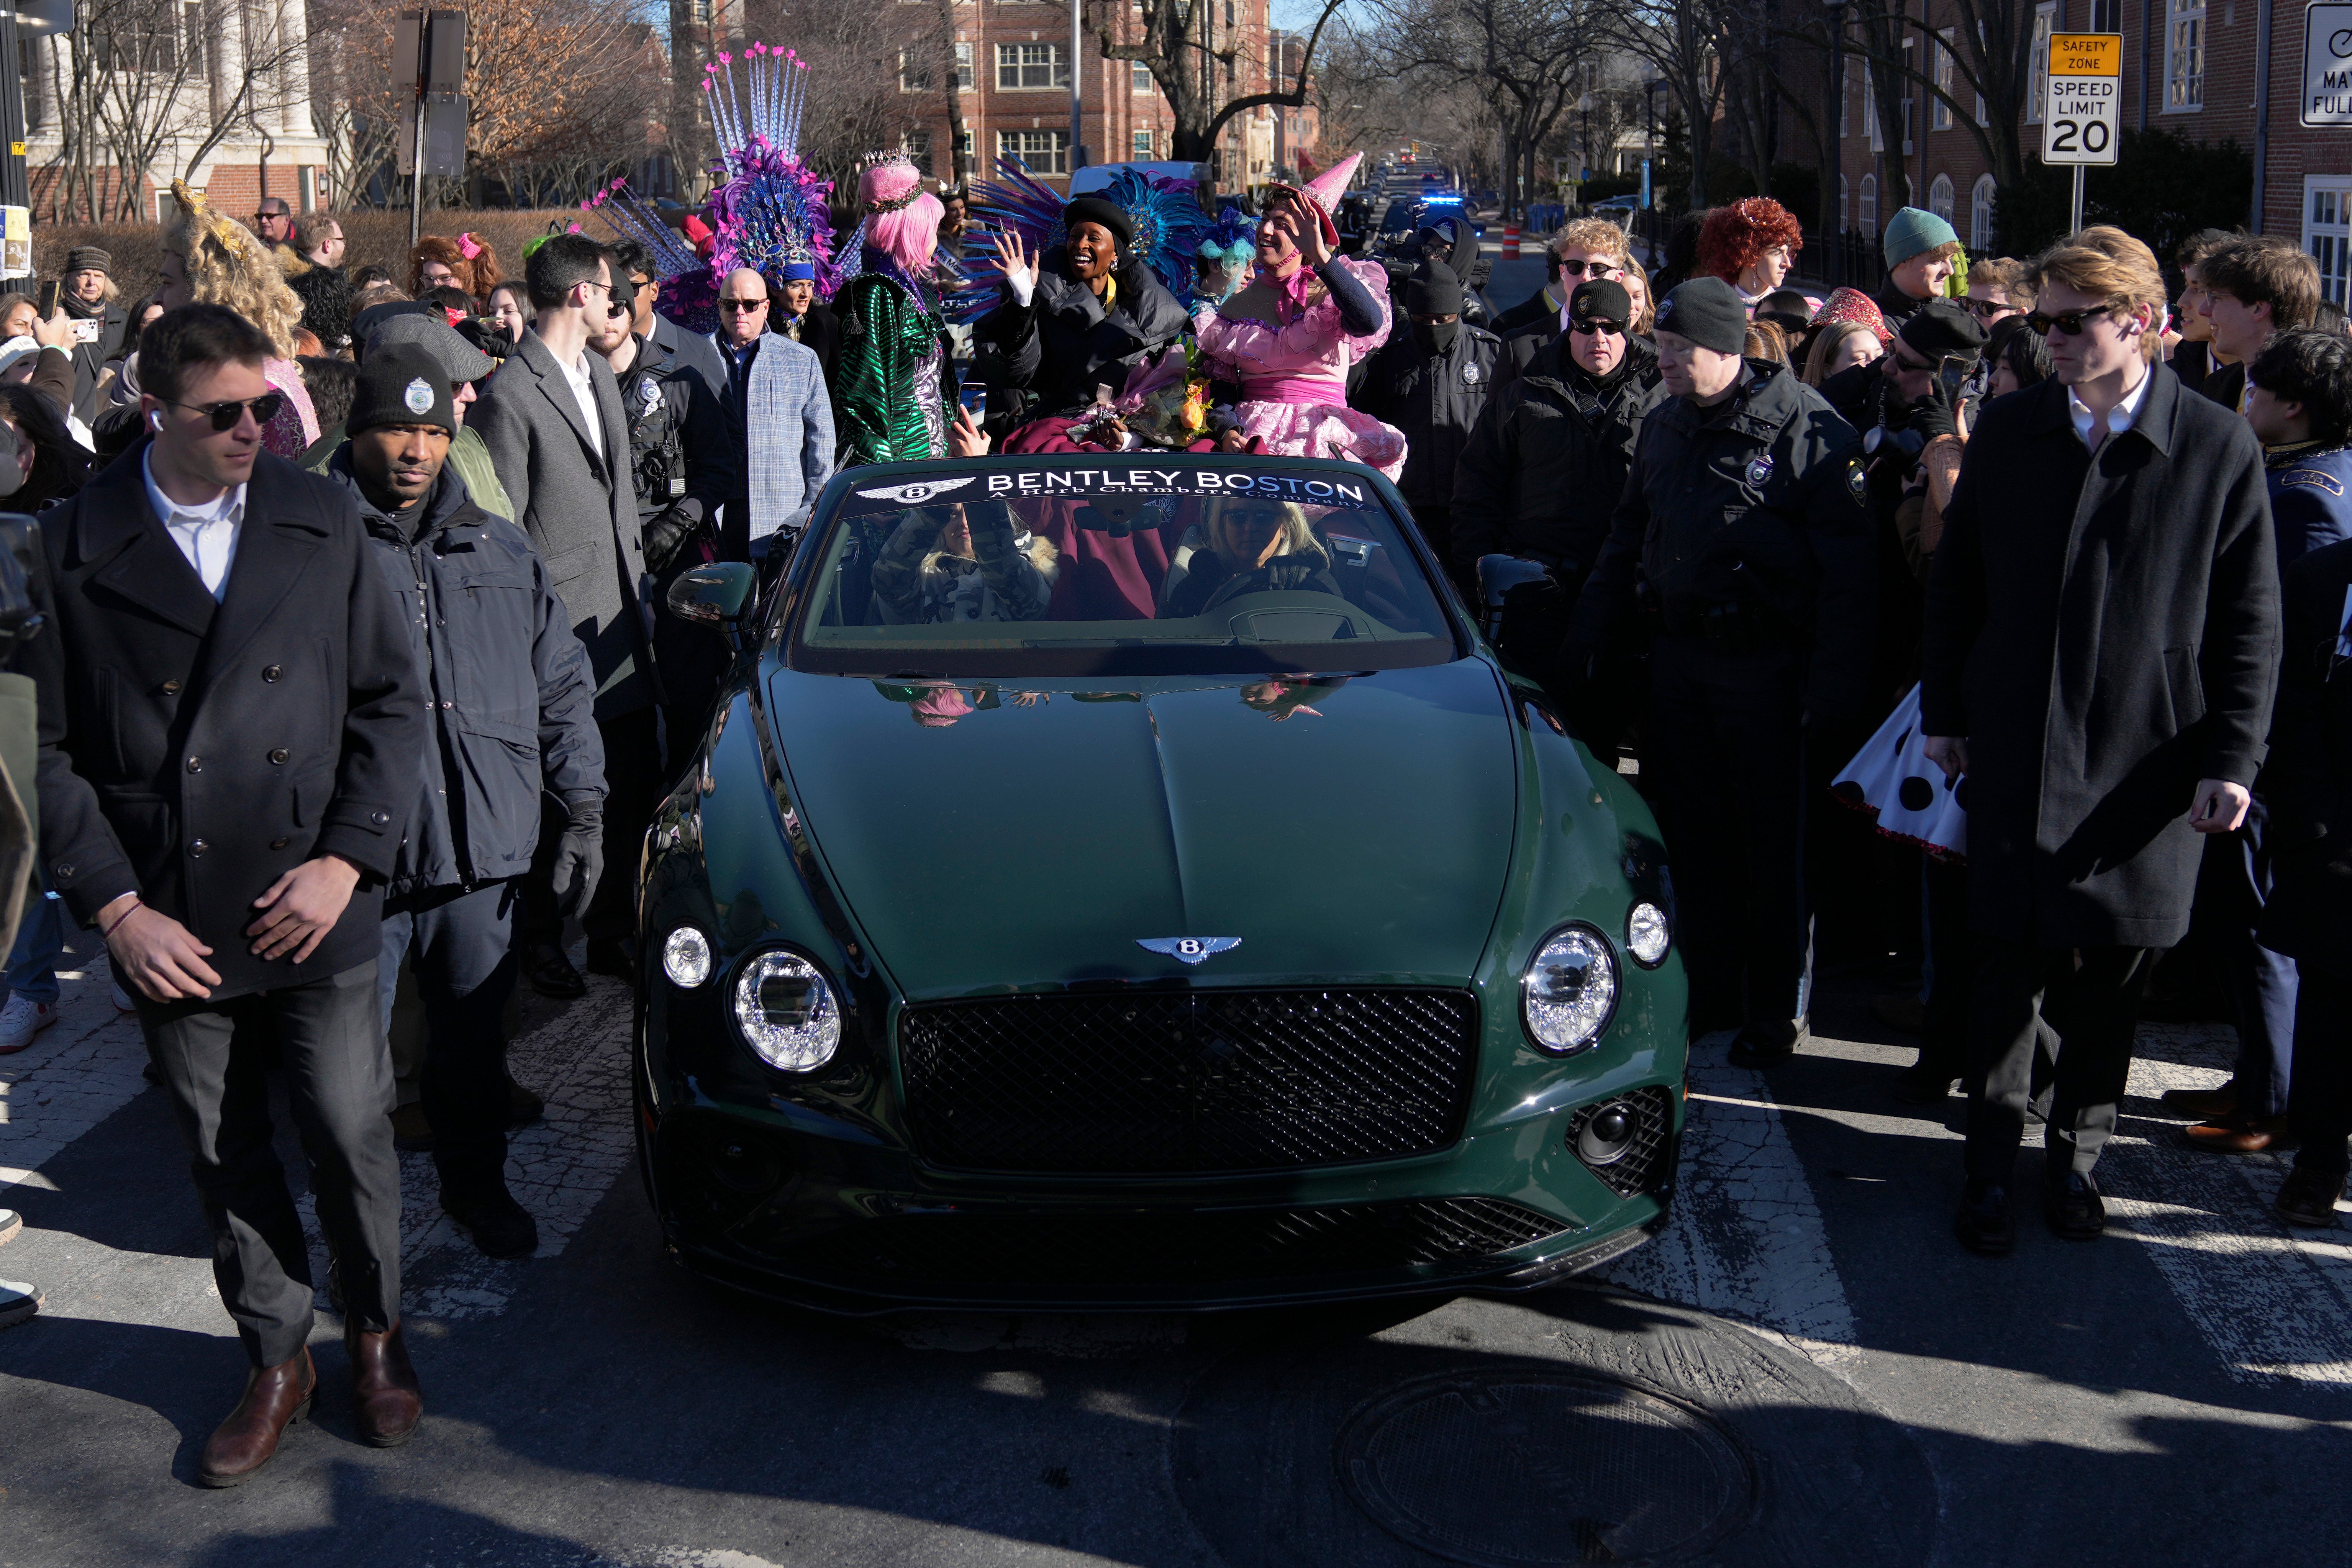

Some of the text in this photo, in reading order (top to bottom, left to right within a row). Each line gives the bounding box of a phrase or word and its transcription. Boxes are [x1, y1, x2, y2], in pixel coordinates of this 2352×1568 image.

[2063, 41, 2108, 51] SAFETY
[2068, 58, 2100, 69] ZONE
[2054, 82, 2113, 96] SPEED
[2059, 101, 2106, 115] LIMIT
[2052, 120, 2109, 152] 20
[934, 246, 968, 275] Miss Mass
[906, 487, 925, 498] B
[988, 470, 1363, 501] BENTLEY BOSTON
[1021, 487, 1085, 495] Herb
[1100, 486, 1231, 495] Chambers
[1245, 491, 1365, 509] Company
[1180, 939, 1200, 954] B
